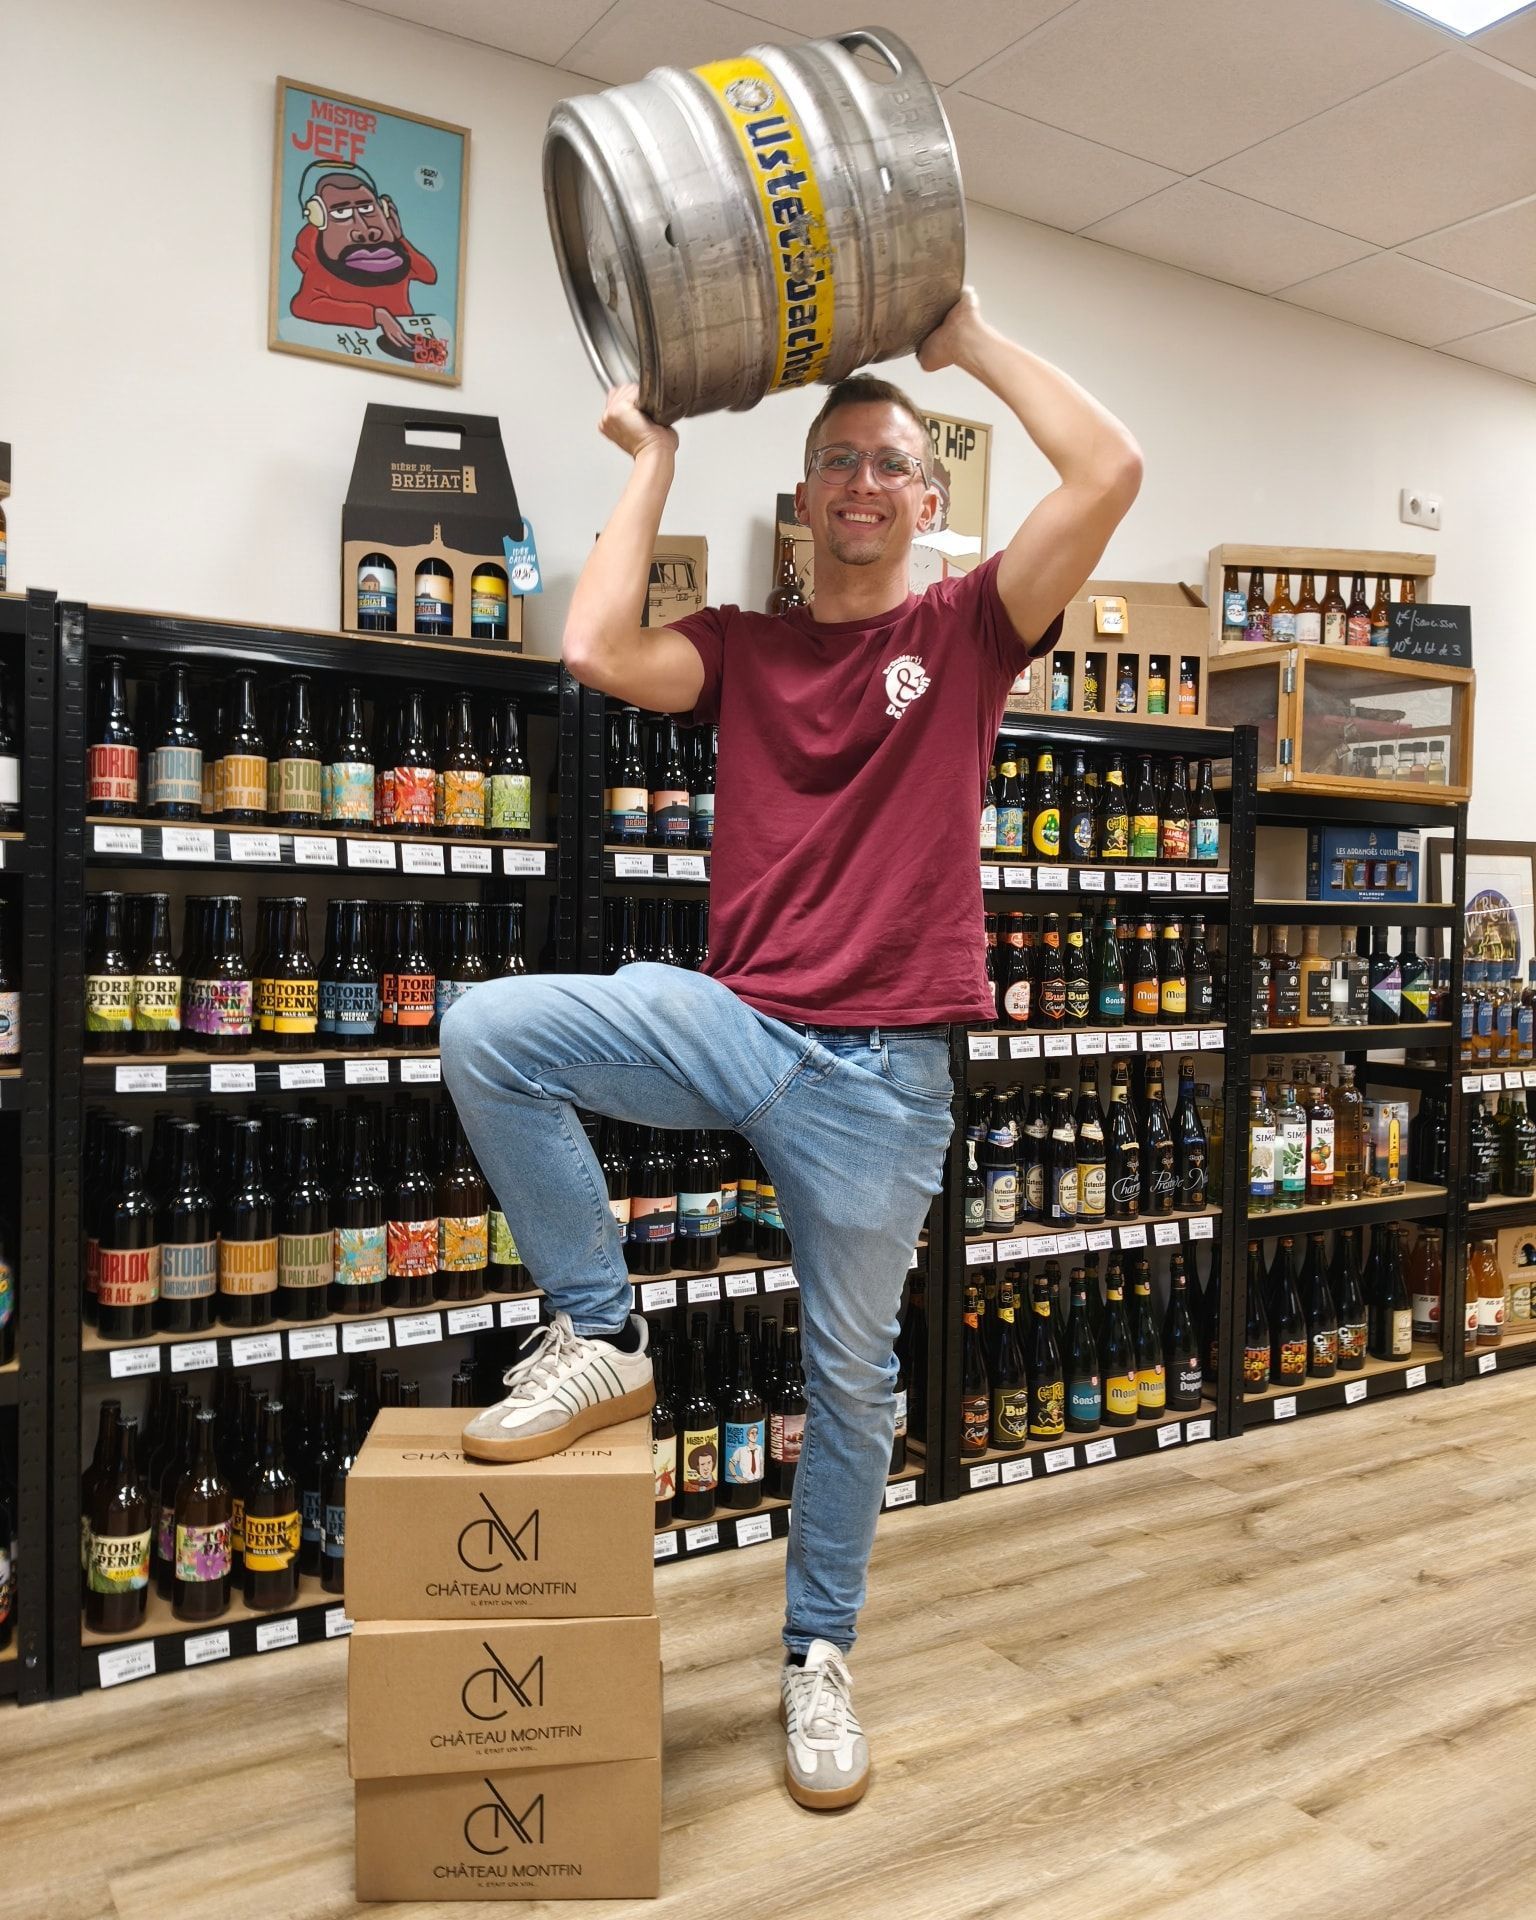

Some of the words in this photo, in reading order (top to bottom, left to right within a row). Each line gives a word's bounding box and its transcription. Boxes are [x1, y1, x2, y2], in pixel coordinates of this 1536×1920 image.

[291, 119, 366, 164] JEFF
[420, 464, 432, 472] DE
[391, 471, 461, 489] BRÉHAT
[115, 782, 131, 798] ALE
[247, 791, 262, 808] ALE
[276, 984, 316, 996] TORR
[336, 985, 374, 998] TORR
[276, 997, 316, 1009] PENN
[336, 999, 374, 1012] PENN
[307, 1267, 319, 1284] ALE
[238, 1278, 252, 1292] ALE
[115, 1287, 131, 1302] ALE
[402, 1452, 466, 1461] CHÂT
[247, 1520, 286, 1535] TORR
[247, 1534, 287, 1547] PENN
[425, 1580, 501, 1597] CHÂTEAU
[506, 1582, 577, 1596] MONTFIN
[430, 1729, 507, 1748] CHÂTEAU
[512, 1724, 583, 1742] MONTFIN
[433, 1862, 507, 1879] CHÂTEAU
[512, 1864, 583, 1877] MONTFIN
